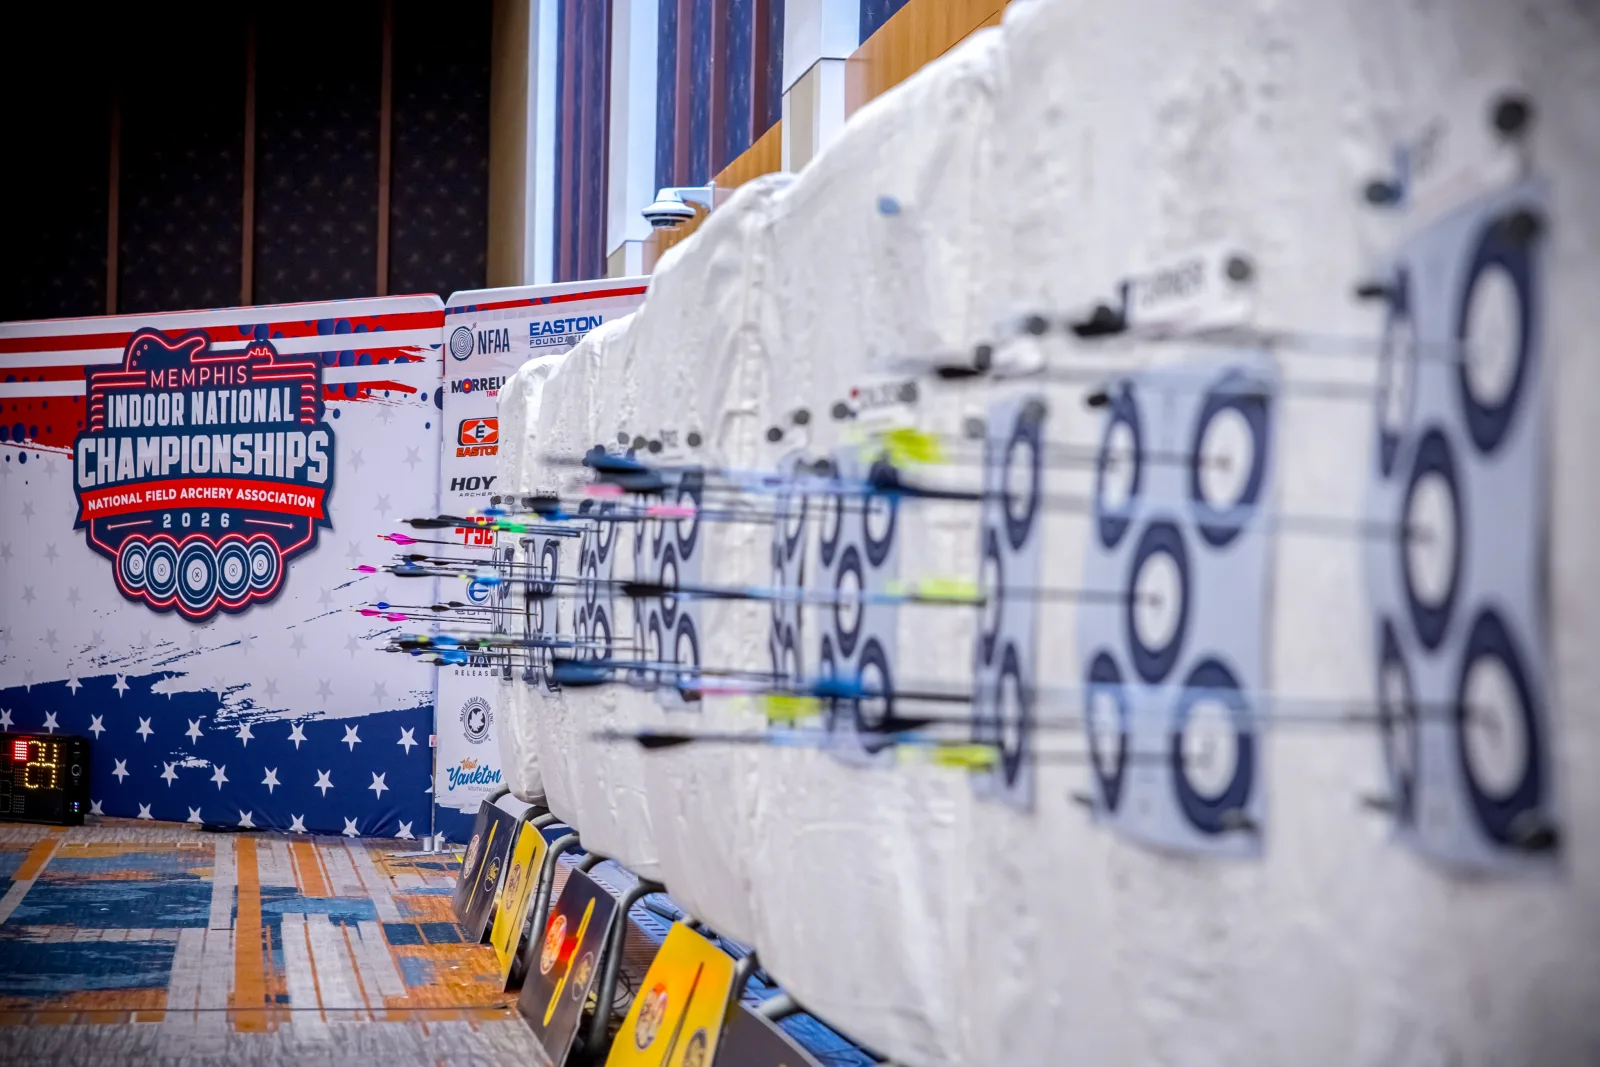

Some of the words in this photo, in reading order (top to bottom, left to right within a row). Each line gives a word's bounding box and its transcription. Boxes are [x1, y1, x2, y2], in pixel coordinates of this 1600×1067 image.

[530, 315, 602, 336] EASTON
[478, 328, 510, 355] NFAA
[150, 365, 247, 388] MEMPHIS
[107, 392, 184, 428] INDOOR
[191, 387, 294, 425] NATIONAL
[77, 430, 329, 489] CHAMPIONSHIPS
[450, 476, 497, 491] HOY
[88, 492, 142, 511] NATIONAL
[145, 488, 177, 503] FIELD
[180, 487, 234, 500] ARCHERY
[236, 488, 315, 509] ASSOCIATION
[163, 513, 230, 528] 2026
[446, 765, 502, 791] Yankton
